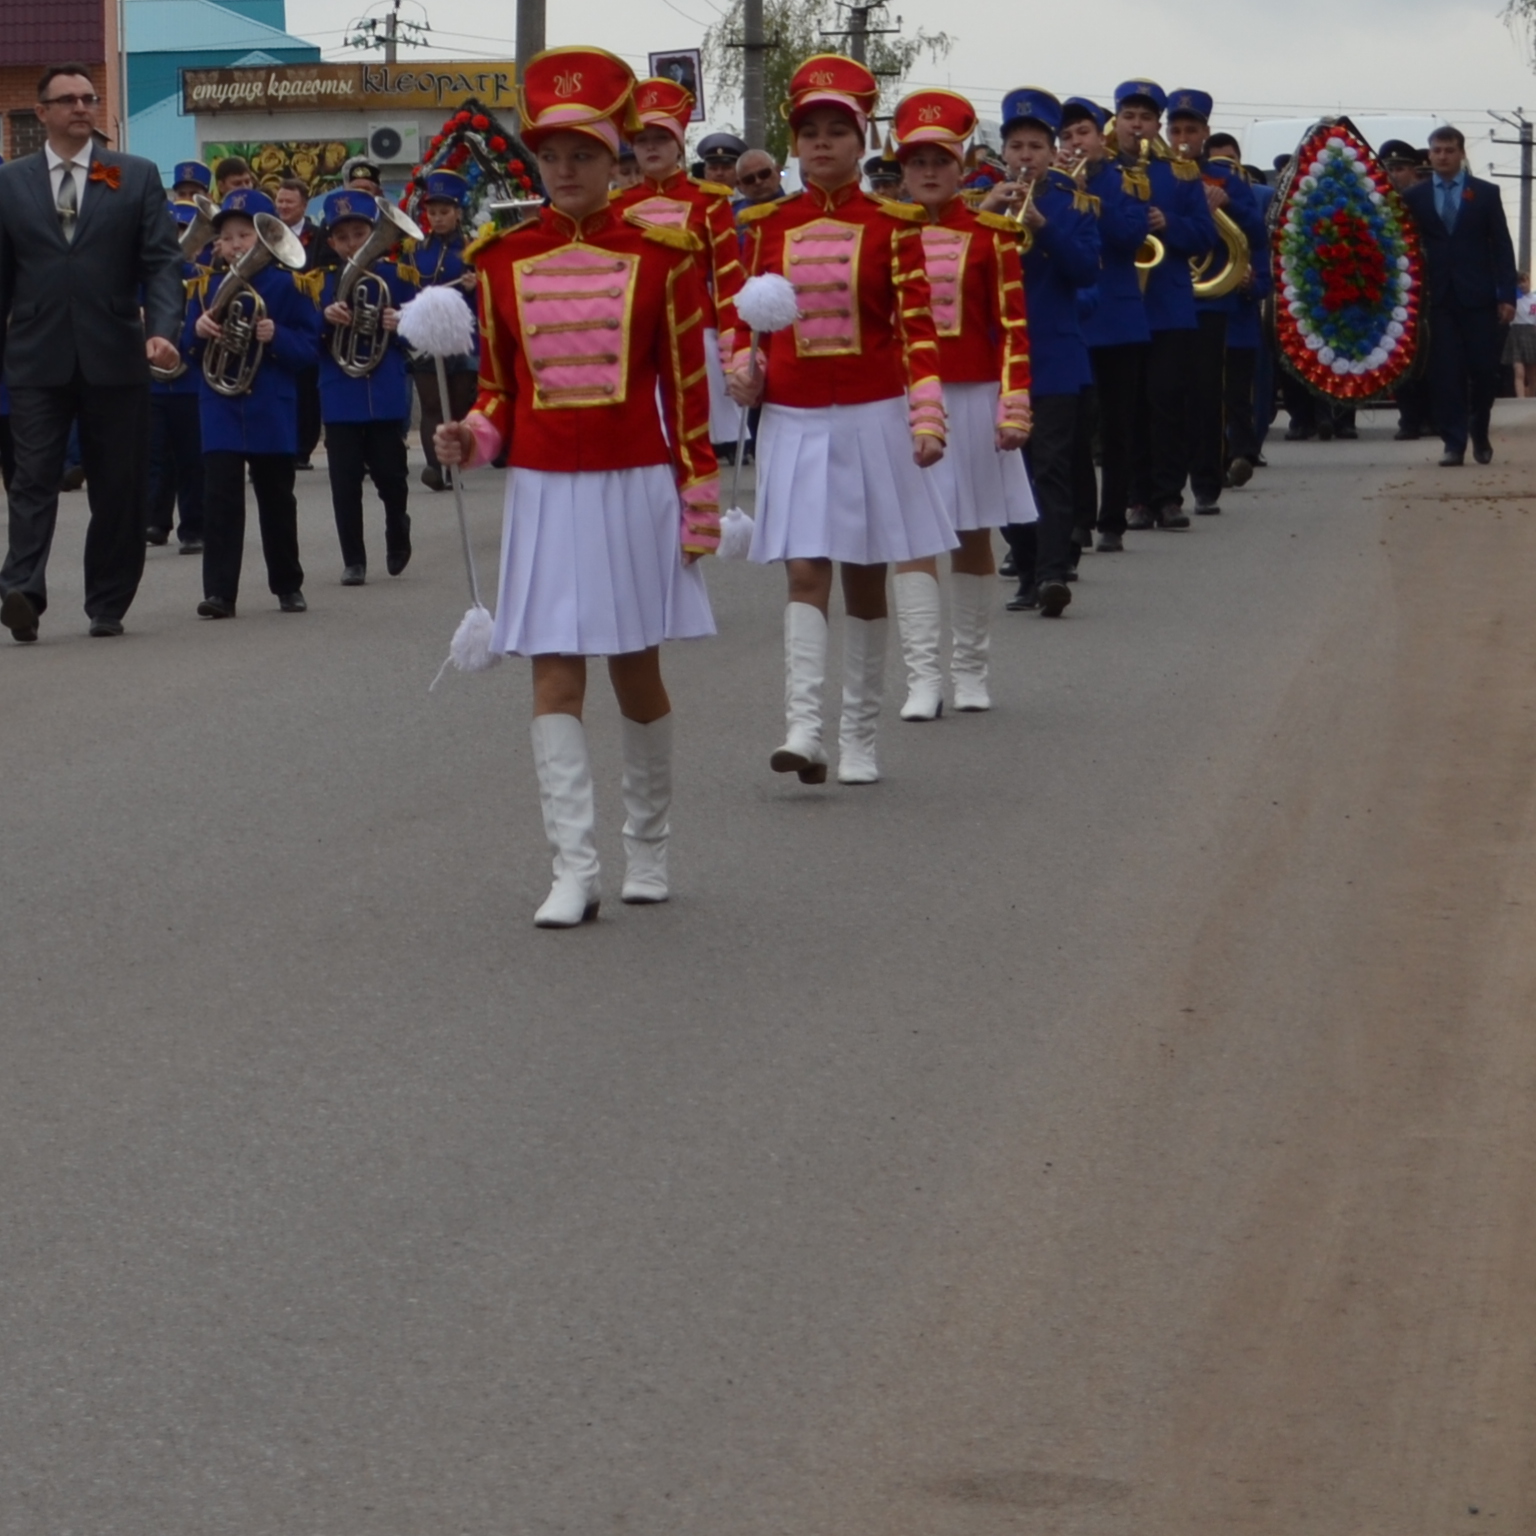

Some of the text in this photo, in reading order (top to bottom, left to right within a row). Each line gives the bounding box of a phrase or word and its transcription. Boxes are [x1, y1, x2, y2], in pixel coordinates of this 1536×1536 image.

[192, 73, 354, 103] студия красоты
[363, 65, 514, 105] KLEOPATR
